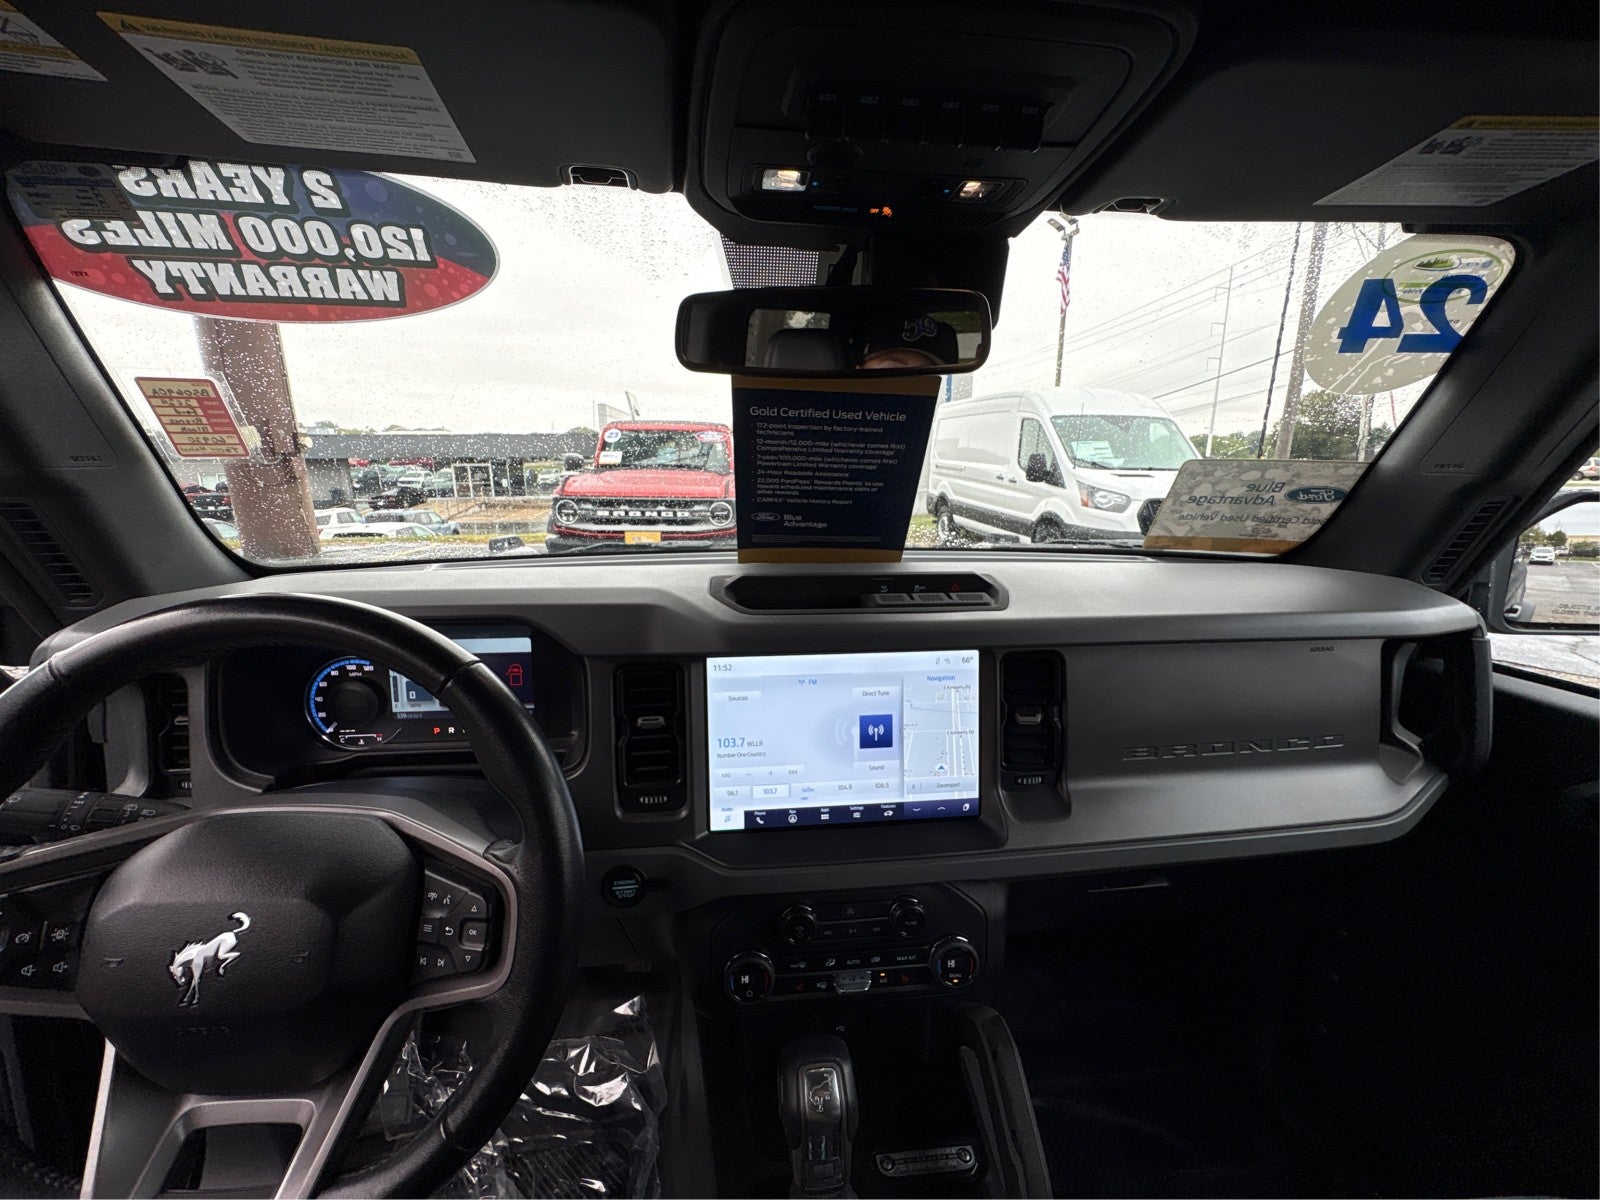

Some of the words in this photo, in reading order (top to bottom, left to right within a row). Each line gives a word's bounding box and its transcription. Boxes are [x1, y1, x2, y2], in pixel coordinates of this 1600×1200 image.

[749, 406, 778, 416] Gold
[780, 407, 830, 418] Certified
[832, 409, 863, 420] Used
[865, 411, 907, 422] Vehicle
[788, 423, 823, 431] inspection
[833, 425, 883, 433] factory-trained
[783, 520, 828, 528] Advantage
[713, 664, 733, 672] 11:52
[927, 674, 956, 682] Navigation
[409, 691, 416, 699] 0
[433, 727, 441, 735] P
[717, 737, 746, 748] 103.7
[1122, 734, 1345, 761] BRONCO
[716, 751, 736, 759] Number
[947, 959, 956, 968] HI
[741, 974, 750, 984] HI
